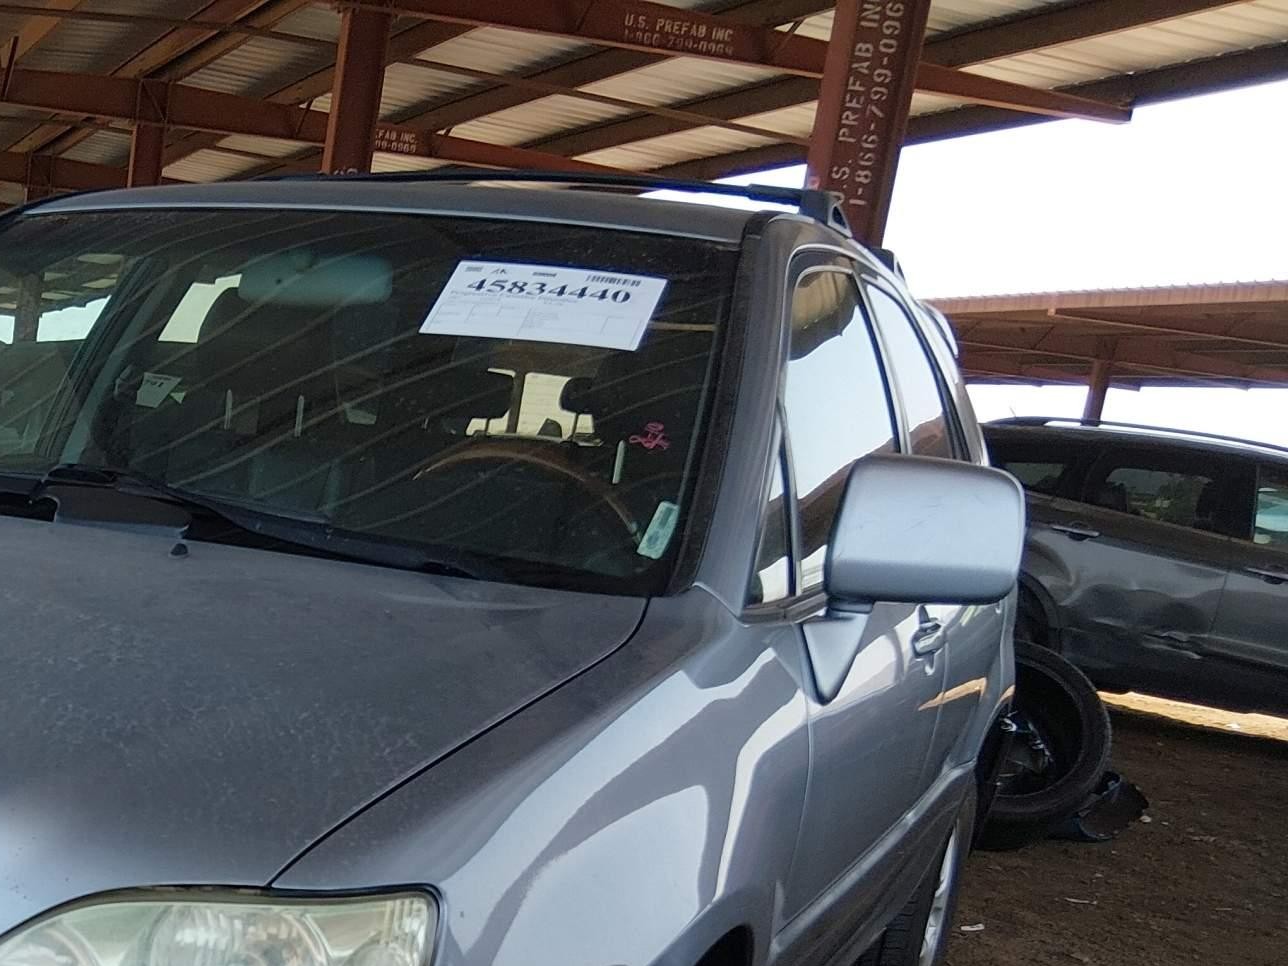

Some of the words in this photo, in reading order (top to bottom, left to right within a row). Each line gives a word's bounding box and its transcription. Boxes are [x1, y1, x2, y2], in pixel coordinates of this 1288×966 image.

[624, 12, 649, 30] U.S.
[655, 17, 708, 39] PREFAB
[838, 42, 873, 143] PREFAB
[859, 0, 883, 28] IN
[467, 278, 632, 304] 45834440
